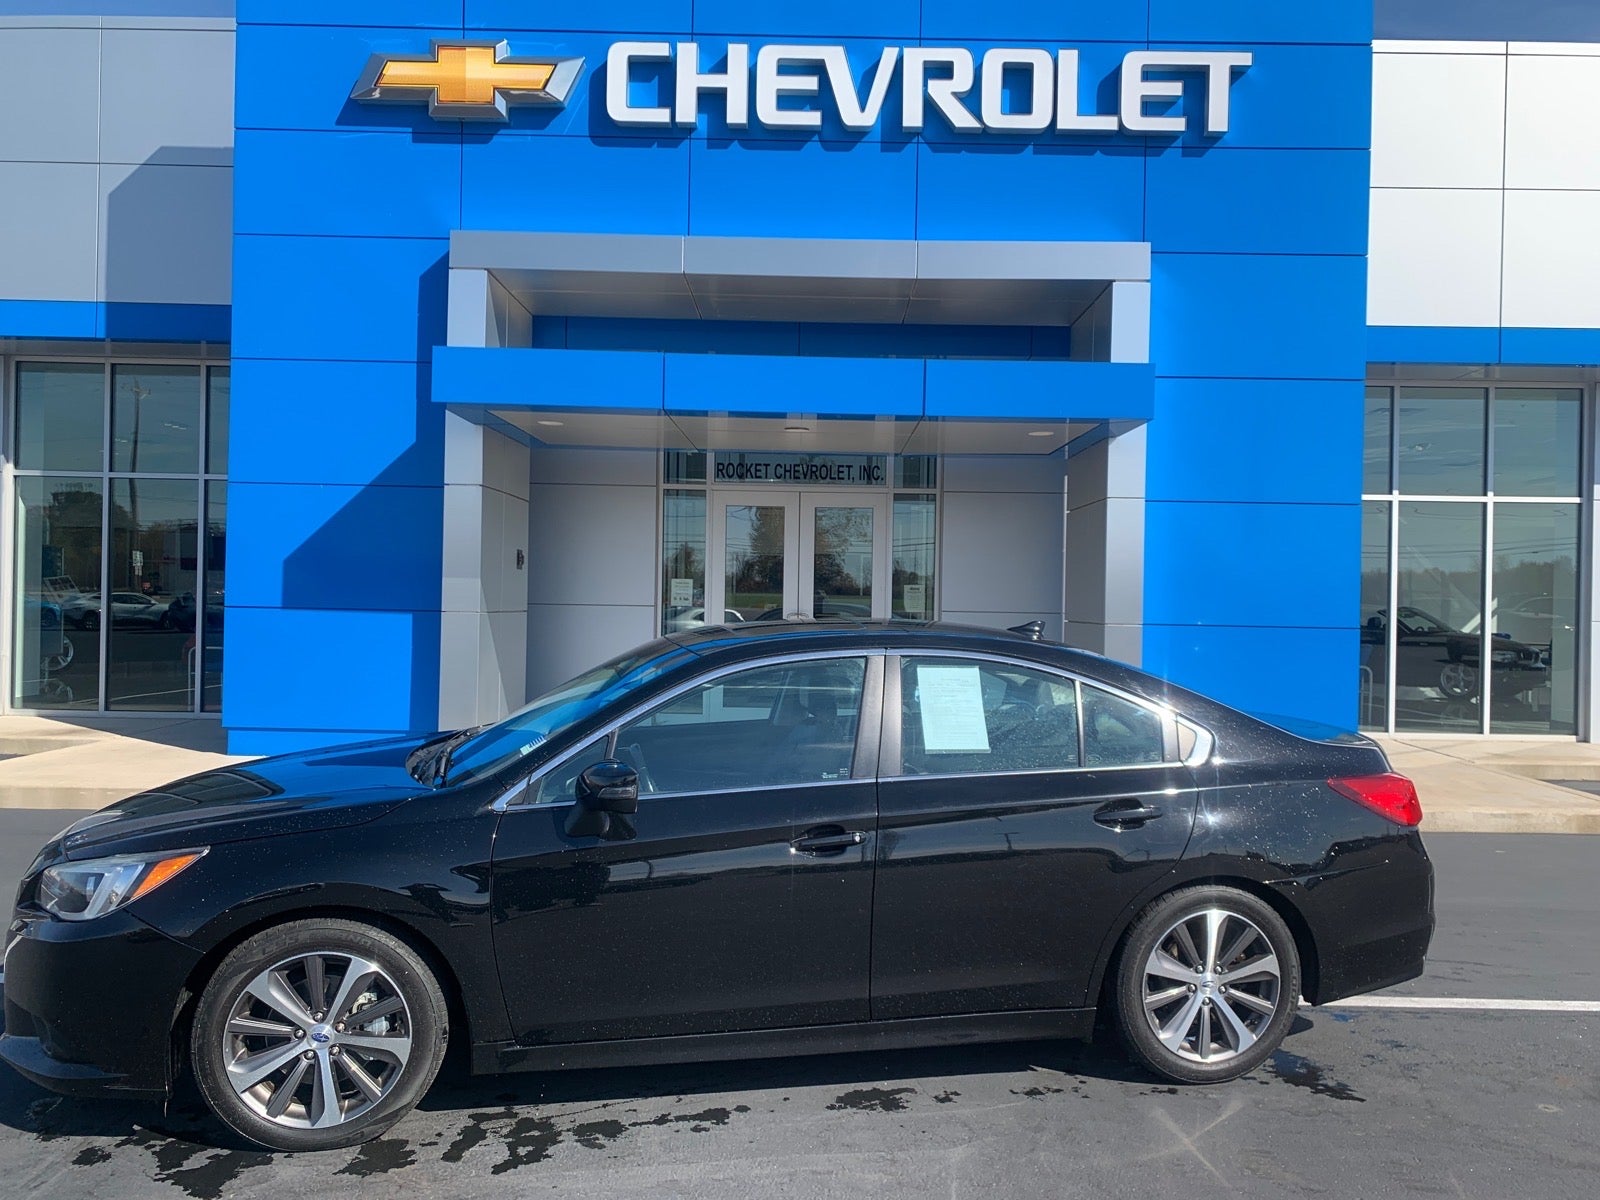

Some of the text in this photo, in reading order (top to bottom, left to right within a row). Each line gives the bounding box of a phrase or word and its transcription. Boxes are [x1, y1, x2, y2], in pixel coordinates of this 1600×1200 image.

[606, 41, 1253, 135] CHEVROLET
[716, 462, 885, 483] ROCKET CHEVROLET, INC.
